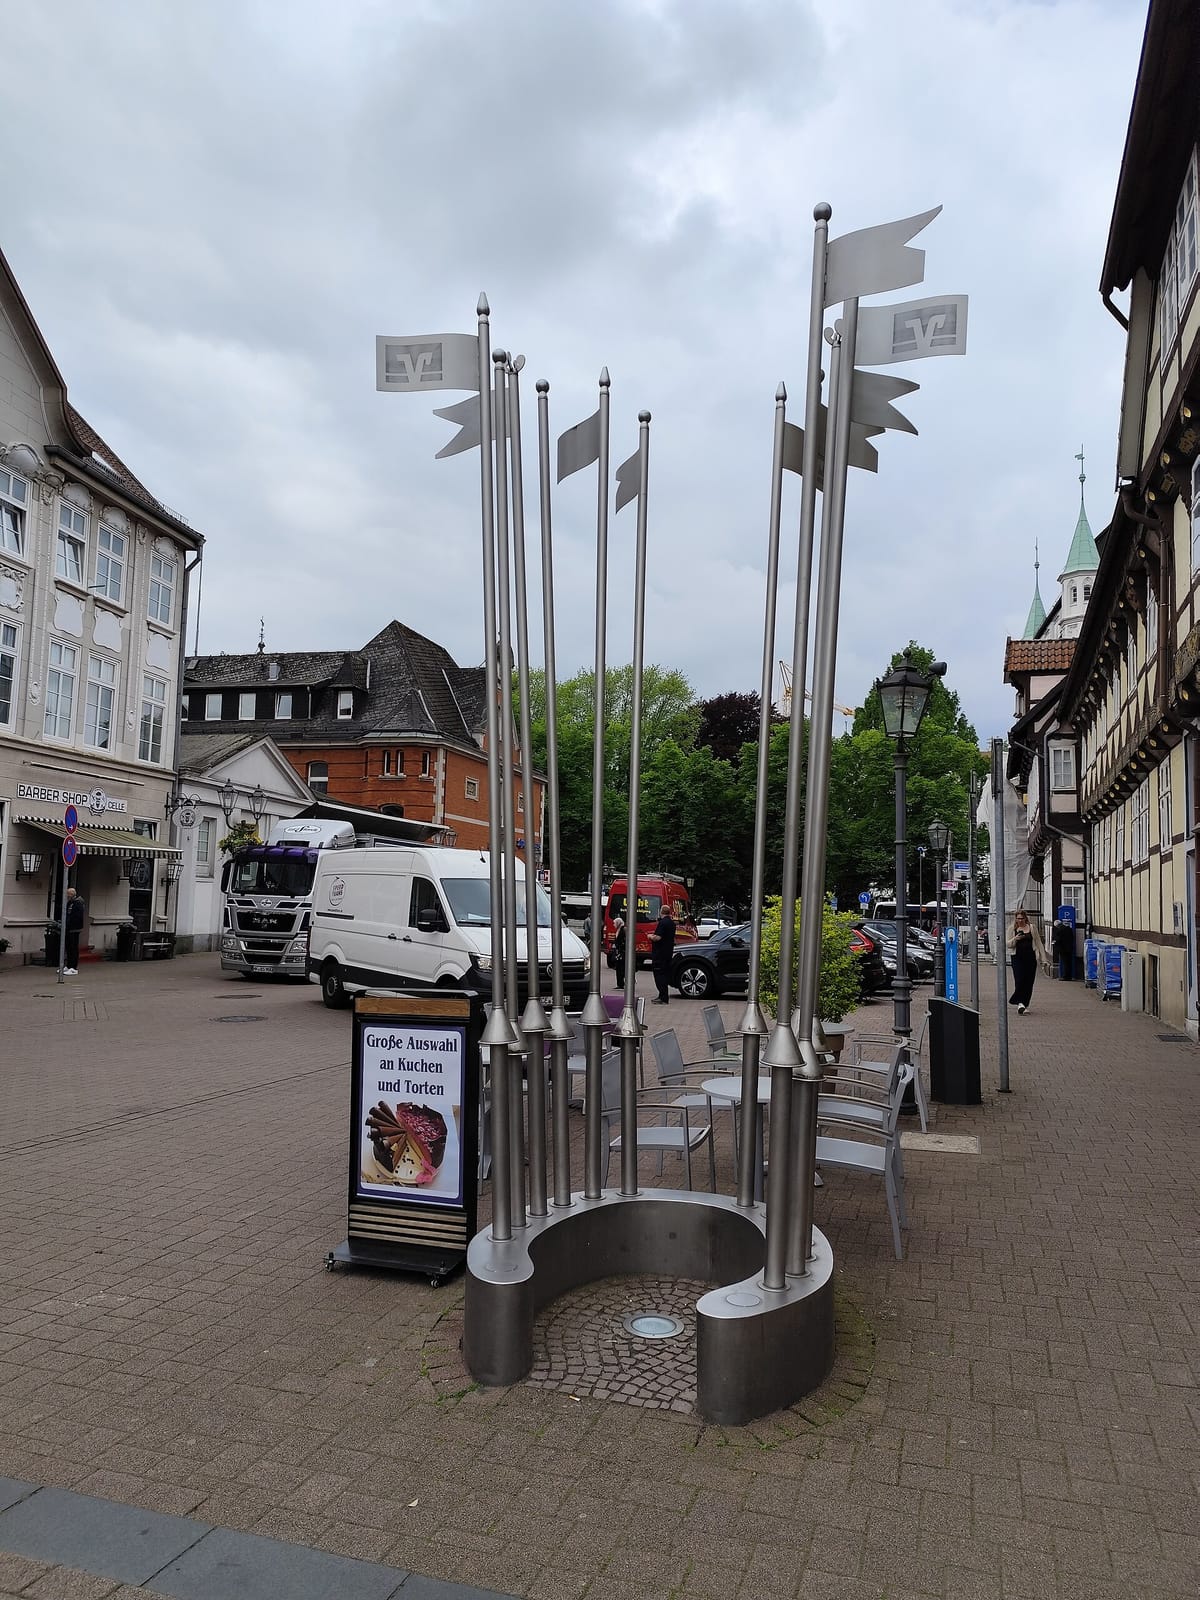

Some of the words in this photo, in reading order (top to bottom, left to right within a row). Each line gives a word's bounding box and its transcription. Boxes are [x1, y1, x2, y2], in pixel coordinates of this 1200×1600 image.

[18, 785, 60, 802] BARBER
[62, 791, 88, 806] SHOP
[107, 801, 125, 810] CELLE
[623, 897, 649, 907] Lht
[366, 1034, 403, 1050] Große
[406, 1036, 457, 1052] Auswahl
[379, 1059, 394, 1070] an
[398, 1057, 443, 1073] Kuchen
[377, 1079, 401, 1093] und
[404, 1080, 444, 1095] Torten
